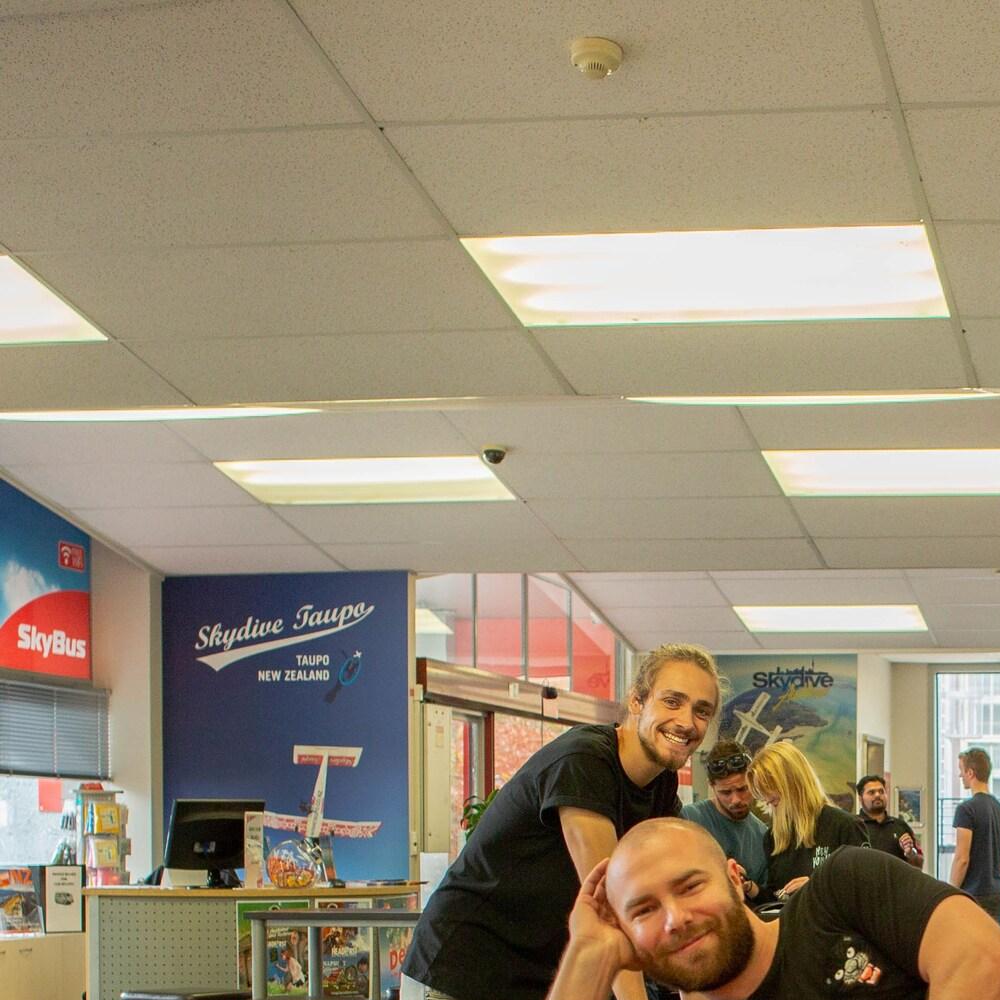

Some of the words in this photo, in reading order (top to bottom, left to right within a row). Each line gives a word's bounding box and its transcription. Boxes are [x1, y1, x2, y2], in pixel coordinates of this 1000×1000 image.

[195, 616, 284, 651] Skydive
[293, 602, 368, 630] Taupo
[17, 623, 87, 659] SkyBus
[296, 655, 330, 666] TAUPO
[258, 670, 281, 681] NEW
[284, 670, 330, 681] ZEALAND
[752, 666, 834, 690] Skydive
